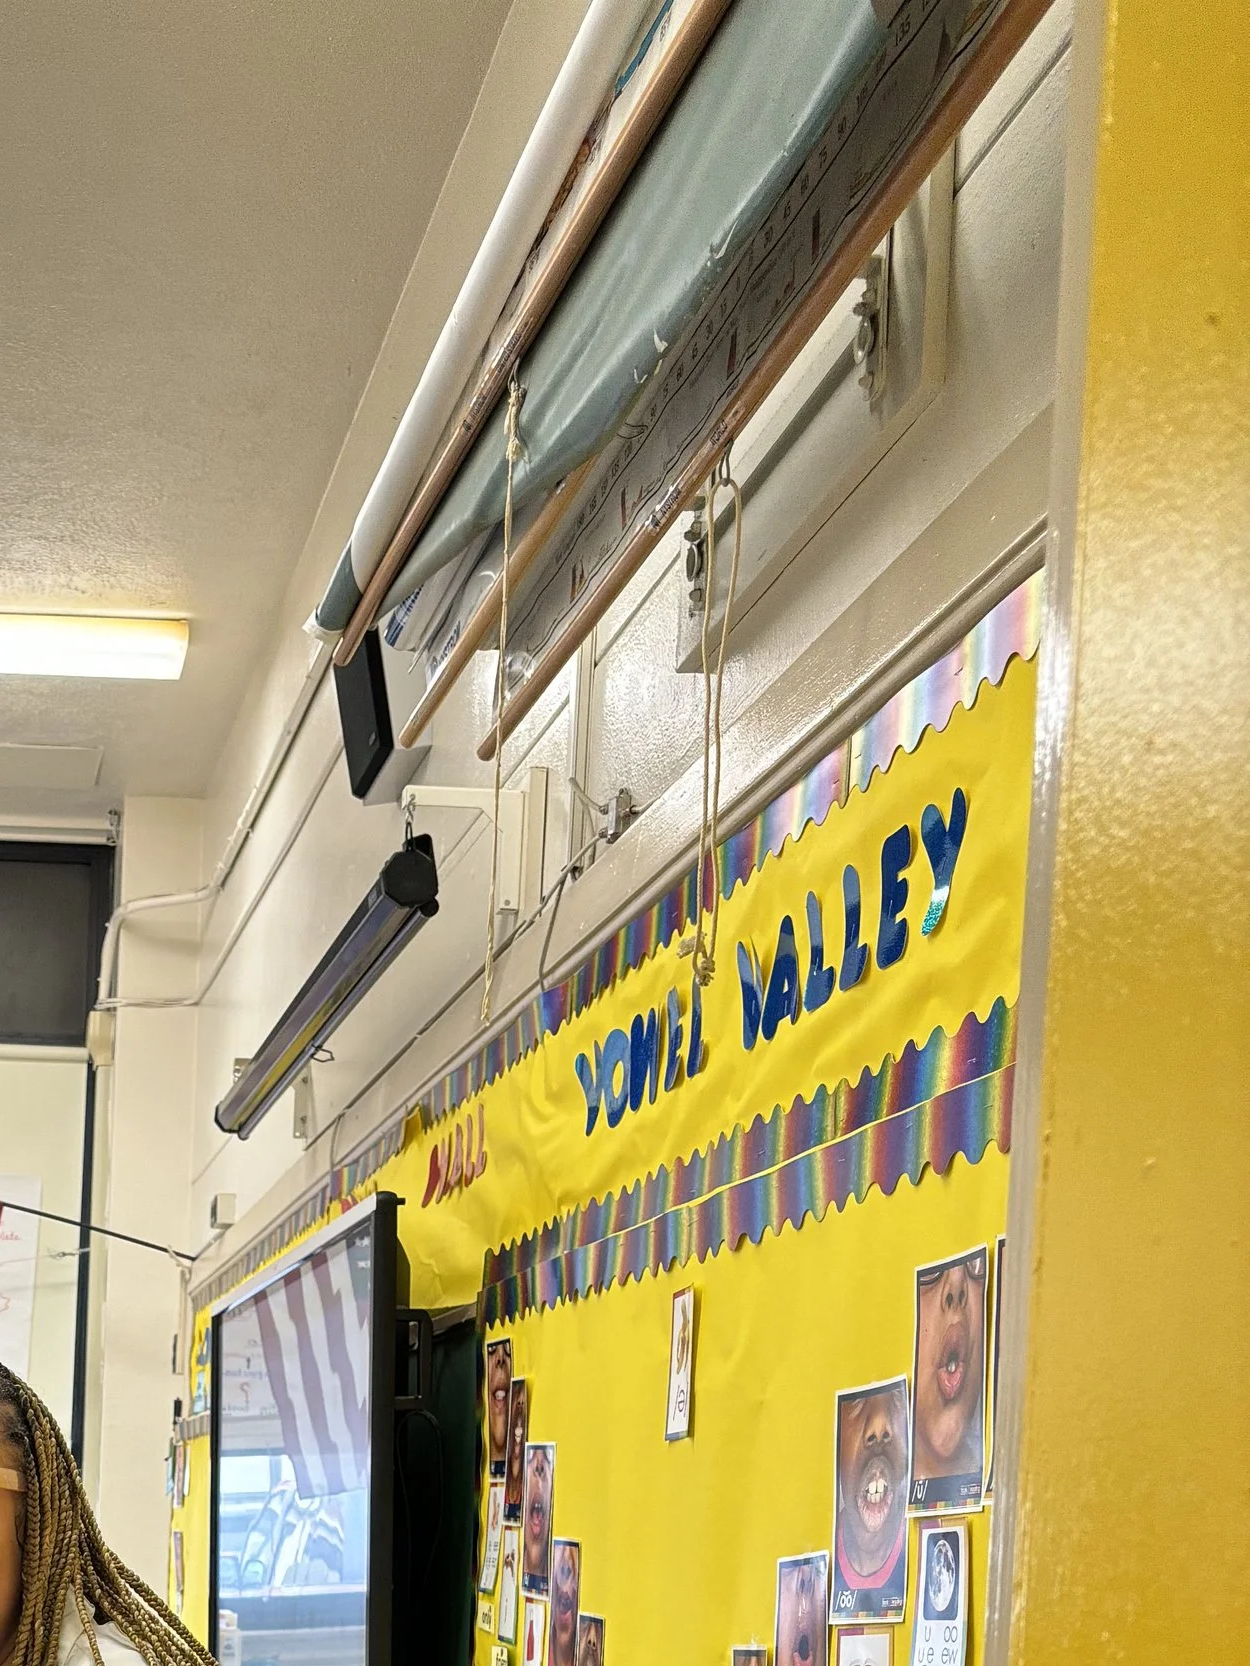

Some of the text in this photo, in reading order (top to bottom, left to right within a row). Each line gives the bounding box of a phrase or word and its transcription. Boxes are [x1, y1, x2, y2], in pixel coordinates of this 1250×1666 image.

[575, 787, 968, 1138] VOWEL VALLEY
[924, 1625, 931, 1642] u
[940, 1648, 958, 1665] ew
